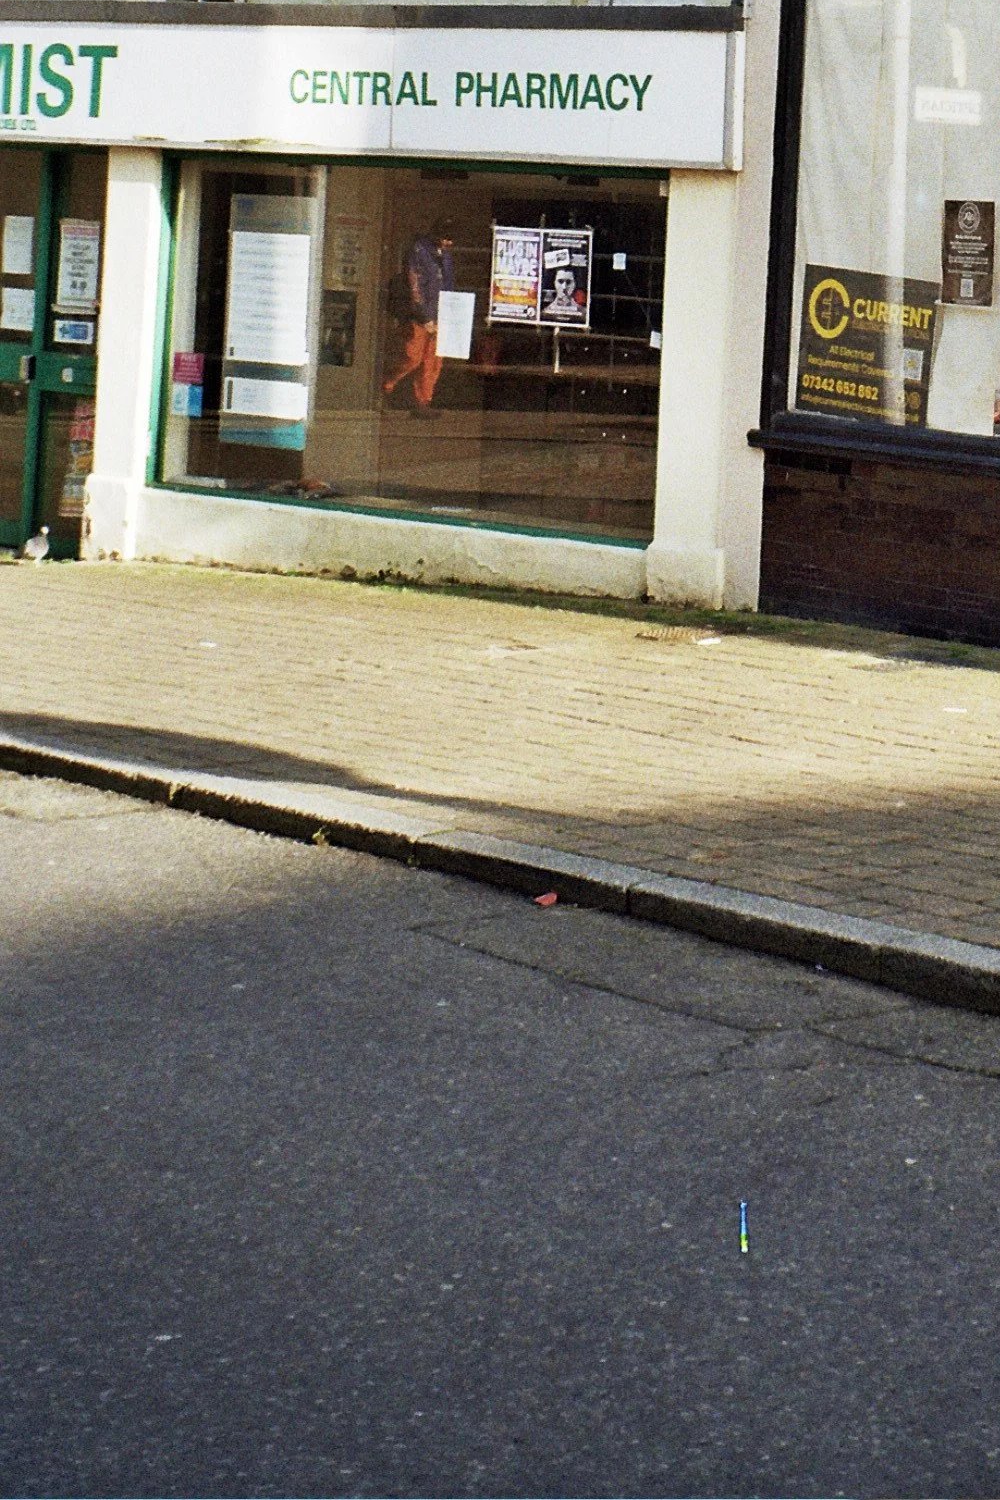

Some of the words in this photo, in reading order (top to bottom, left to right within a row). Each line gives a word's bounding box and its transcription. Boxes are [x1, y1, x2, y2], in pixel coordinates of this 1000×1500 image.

[0, 43, 118, 118] IST
[290, 69, 438, 106] CENTRAL
[454, 71, 653, 111] PHARMACY
[853, 298, 933, 329] CURRENT
[801, 373, 835, 392] 07342
